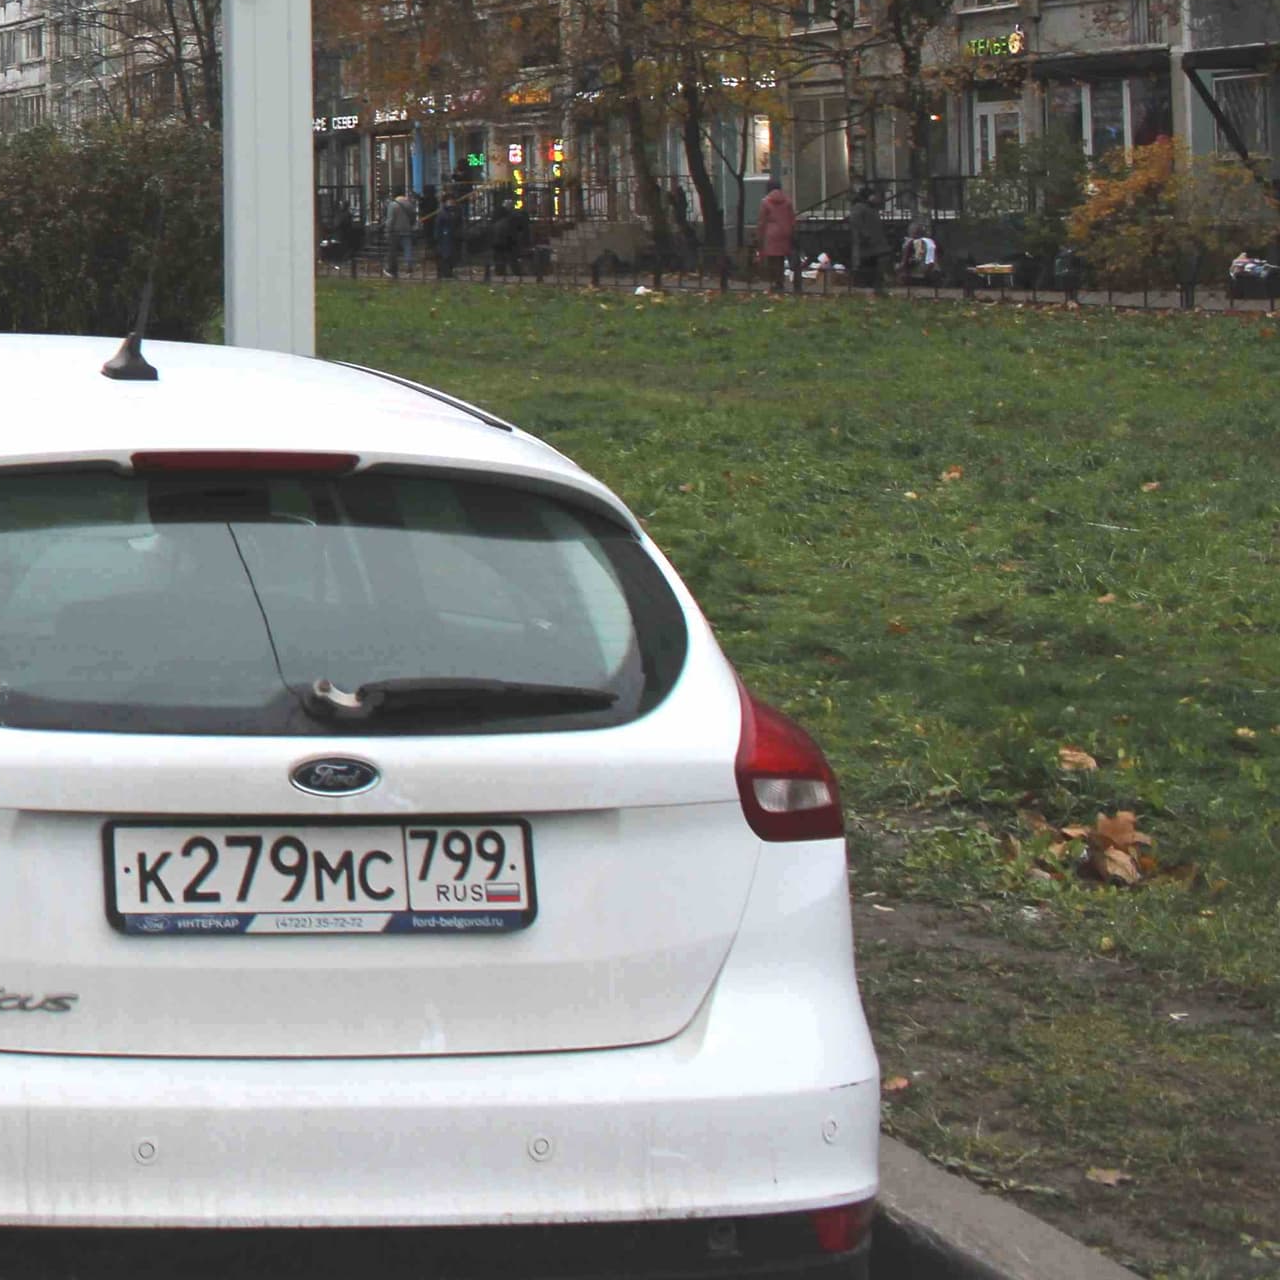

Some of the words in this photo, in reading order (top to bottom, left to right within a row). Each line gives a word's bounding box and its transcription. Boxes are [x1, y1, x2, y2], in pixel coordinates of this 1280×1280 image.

[137, 835, 395, 903] К279МС
[409, 829, 506, 881] 799
[436, 884, 484, 902] RUS
[177, 919, 239, 929] ИНТЕРКАР
[275, 917, 311, 929] (4722)
[315, 918, 363, 928] 35-72-72
